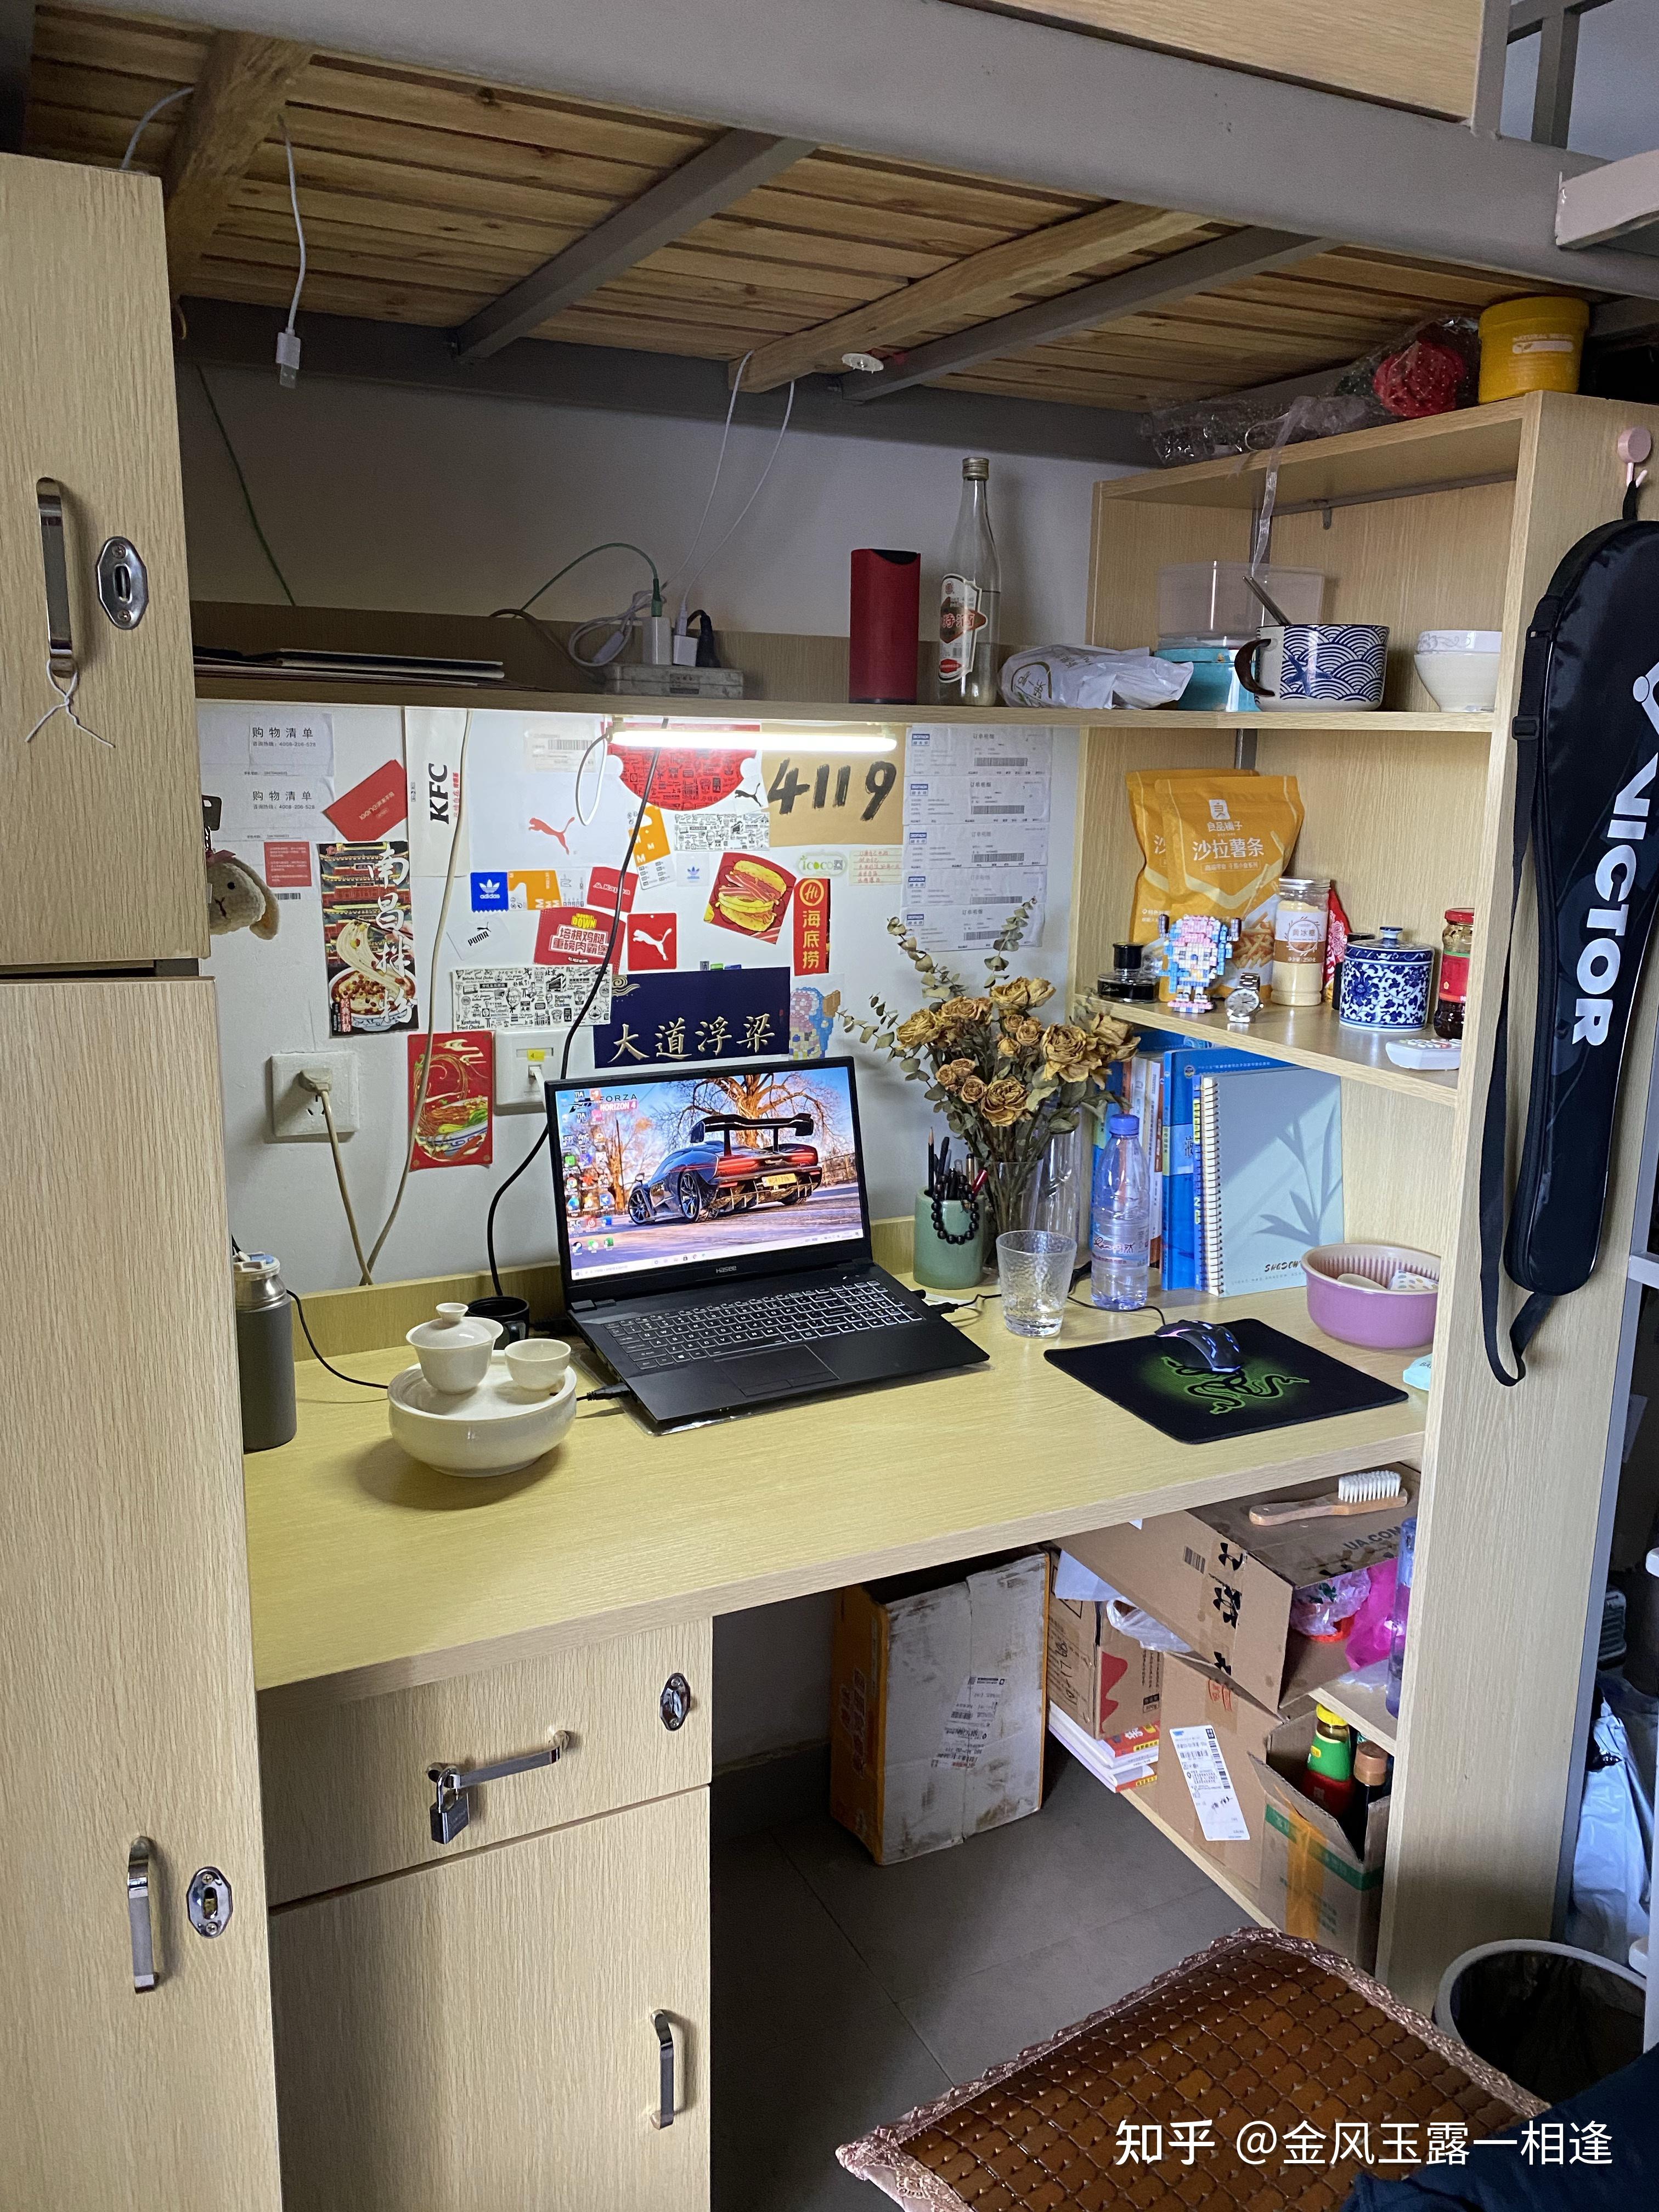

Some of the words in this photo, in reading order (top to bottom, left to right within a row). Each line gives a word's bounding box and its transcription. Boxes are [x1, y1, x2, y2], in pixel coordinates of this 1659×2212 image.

[252, 727, 313, 738] 购物清单
[252, 791, 312, 801] 购物清单
[428, 763, 449, 825] KFC
[767, 757, 897, 821] 4119
[1207, 821, 1242, 832] 良品铺子
[1192, 837, 1264, 861] 沙拉薯条
[1571, 752, 1659, 1046] VICTOR
[367, 841, 417, 1024] 南昌拌粉
[572, 917, 596, 929] DOWN
[467, 931, 489, 946] PUMA
[552, 938, 608, 956] 重磅肉霸堡
[560, 928, 605, 944] 培根鸡腿
[802, 910, 821, 969] 海底捞
[607, 1013, 775, 1063] 大道浮梁
[1343, 1526, 1401, 1550] UA.COM
